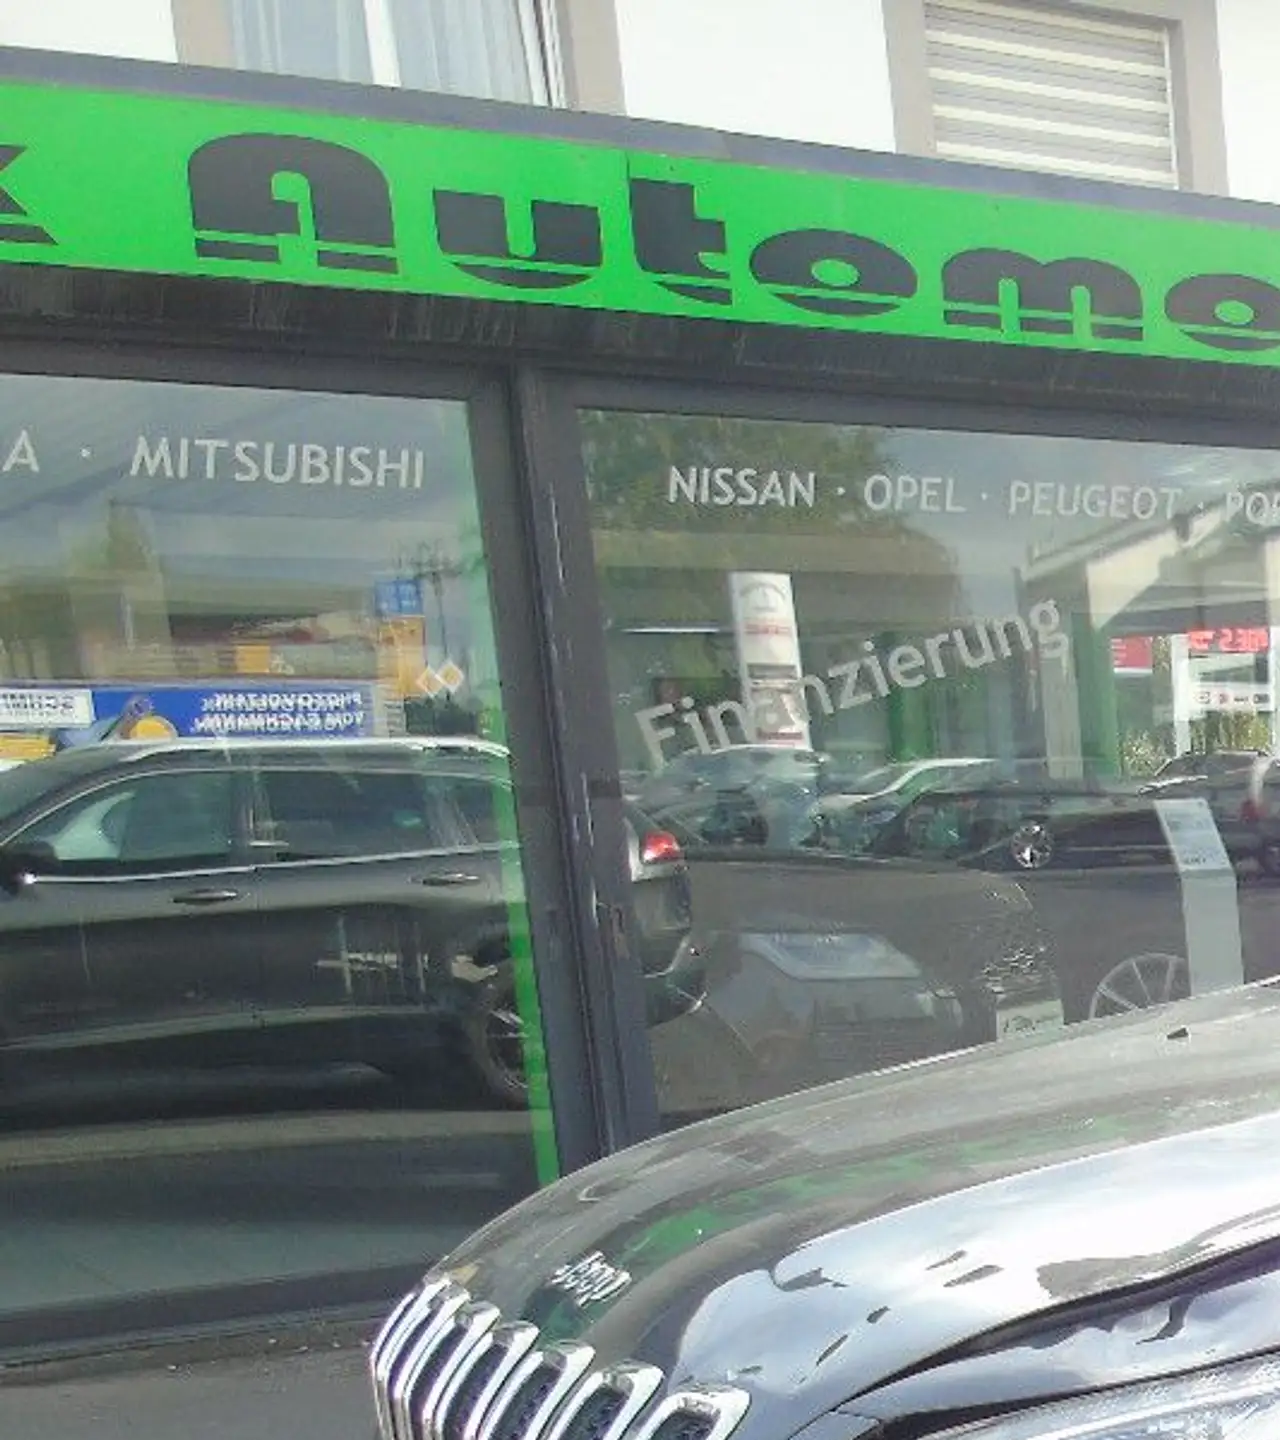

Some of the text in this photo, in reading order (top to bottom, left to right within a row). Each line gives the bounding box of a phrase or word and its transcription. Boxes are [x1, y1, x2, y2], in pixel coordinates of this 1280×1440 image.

[130, 436, 424, 490] MITSUBISHI
[667, 466, 816, 508] NISSAN
[863, 476, 966, 514] OPEL
[1008, 482, 1184, 522] PEUGEOT
[634, 600, 1069, 769] Finanzierung
